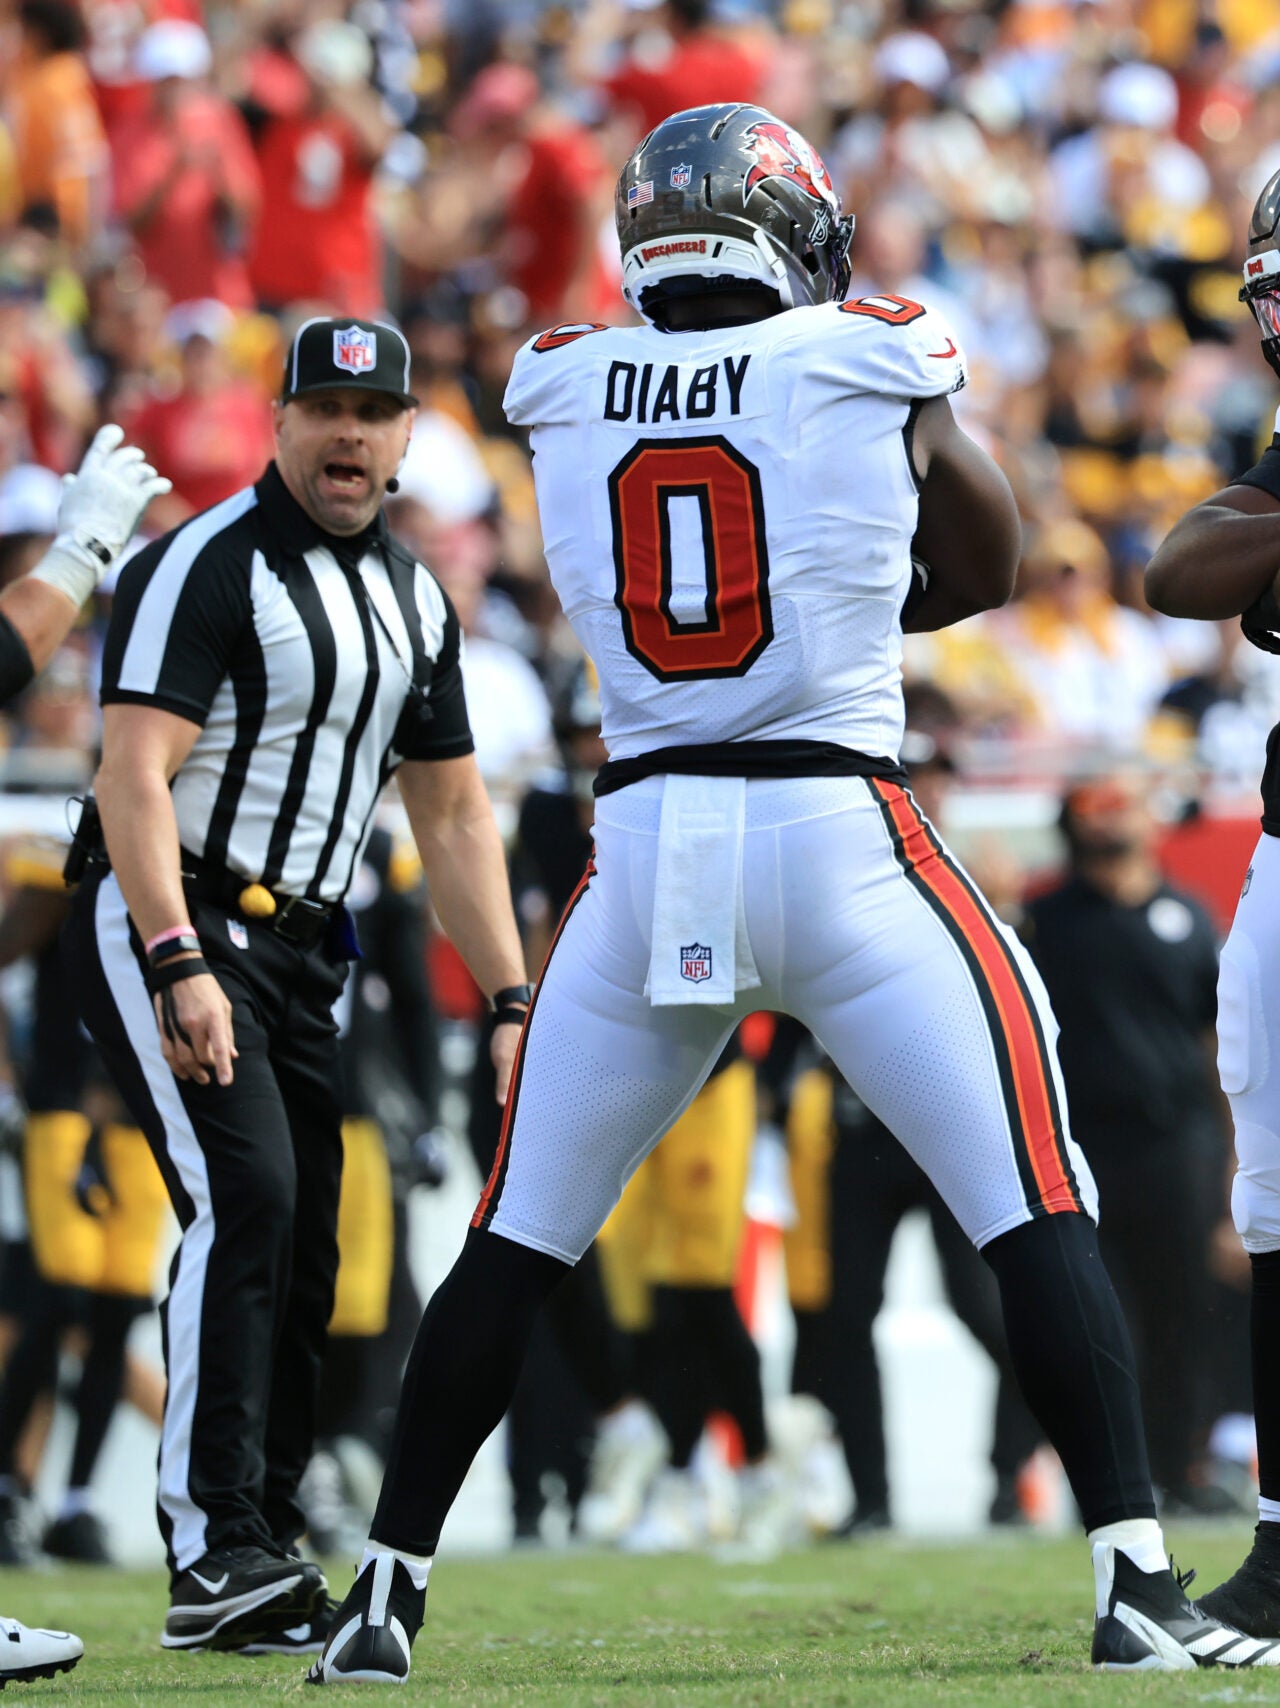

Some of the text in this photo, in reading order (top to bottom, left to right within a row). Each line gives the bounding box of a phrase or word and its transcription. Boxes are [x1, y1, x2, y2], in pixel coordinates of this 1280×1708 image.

[673, 173, 689, 184] NFL
[641, 239, 707, 262] BUCCANEERS
[339, 345, 372, 368] NFL
[603, 354, 752, 424] DIABY
[607, 434, 774, 684] 0
[684, 961, 708, 978] NFL
